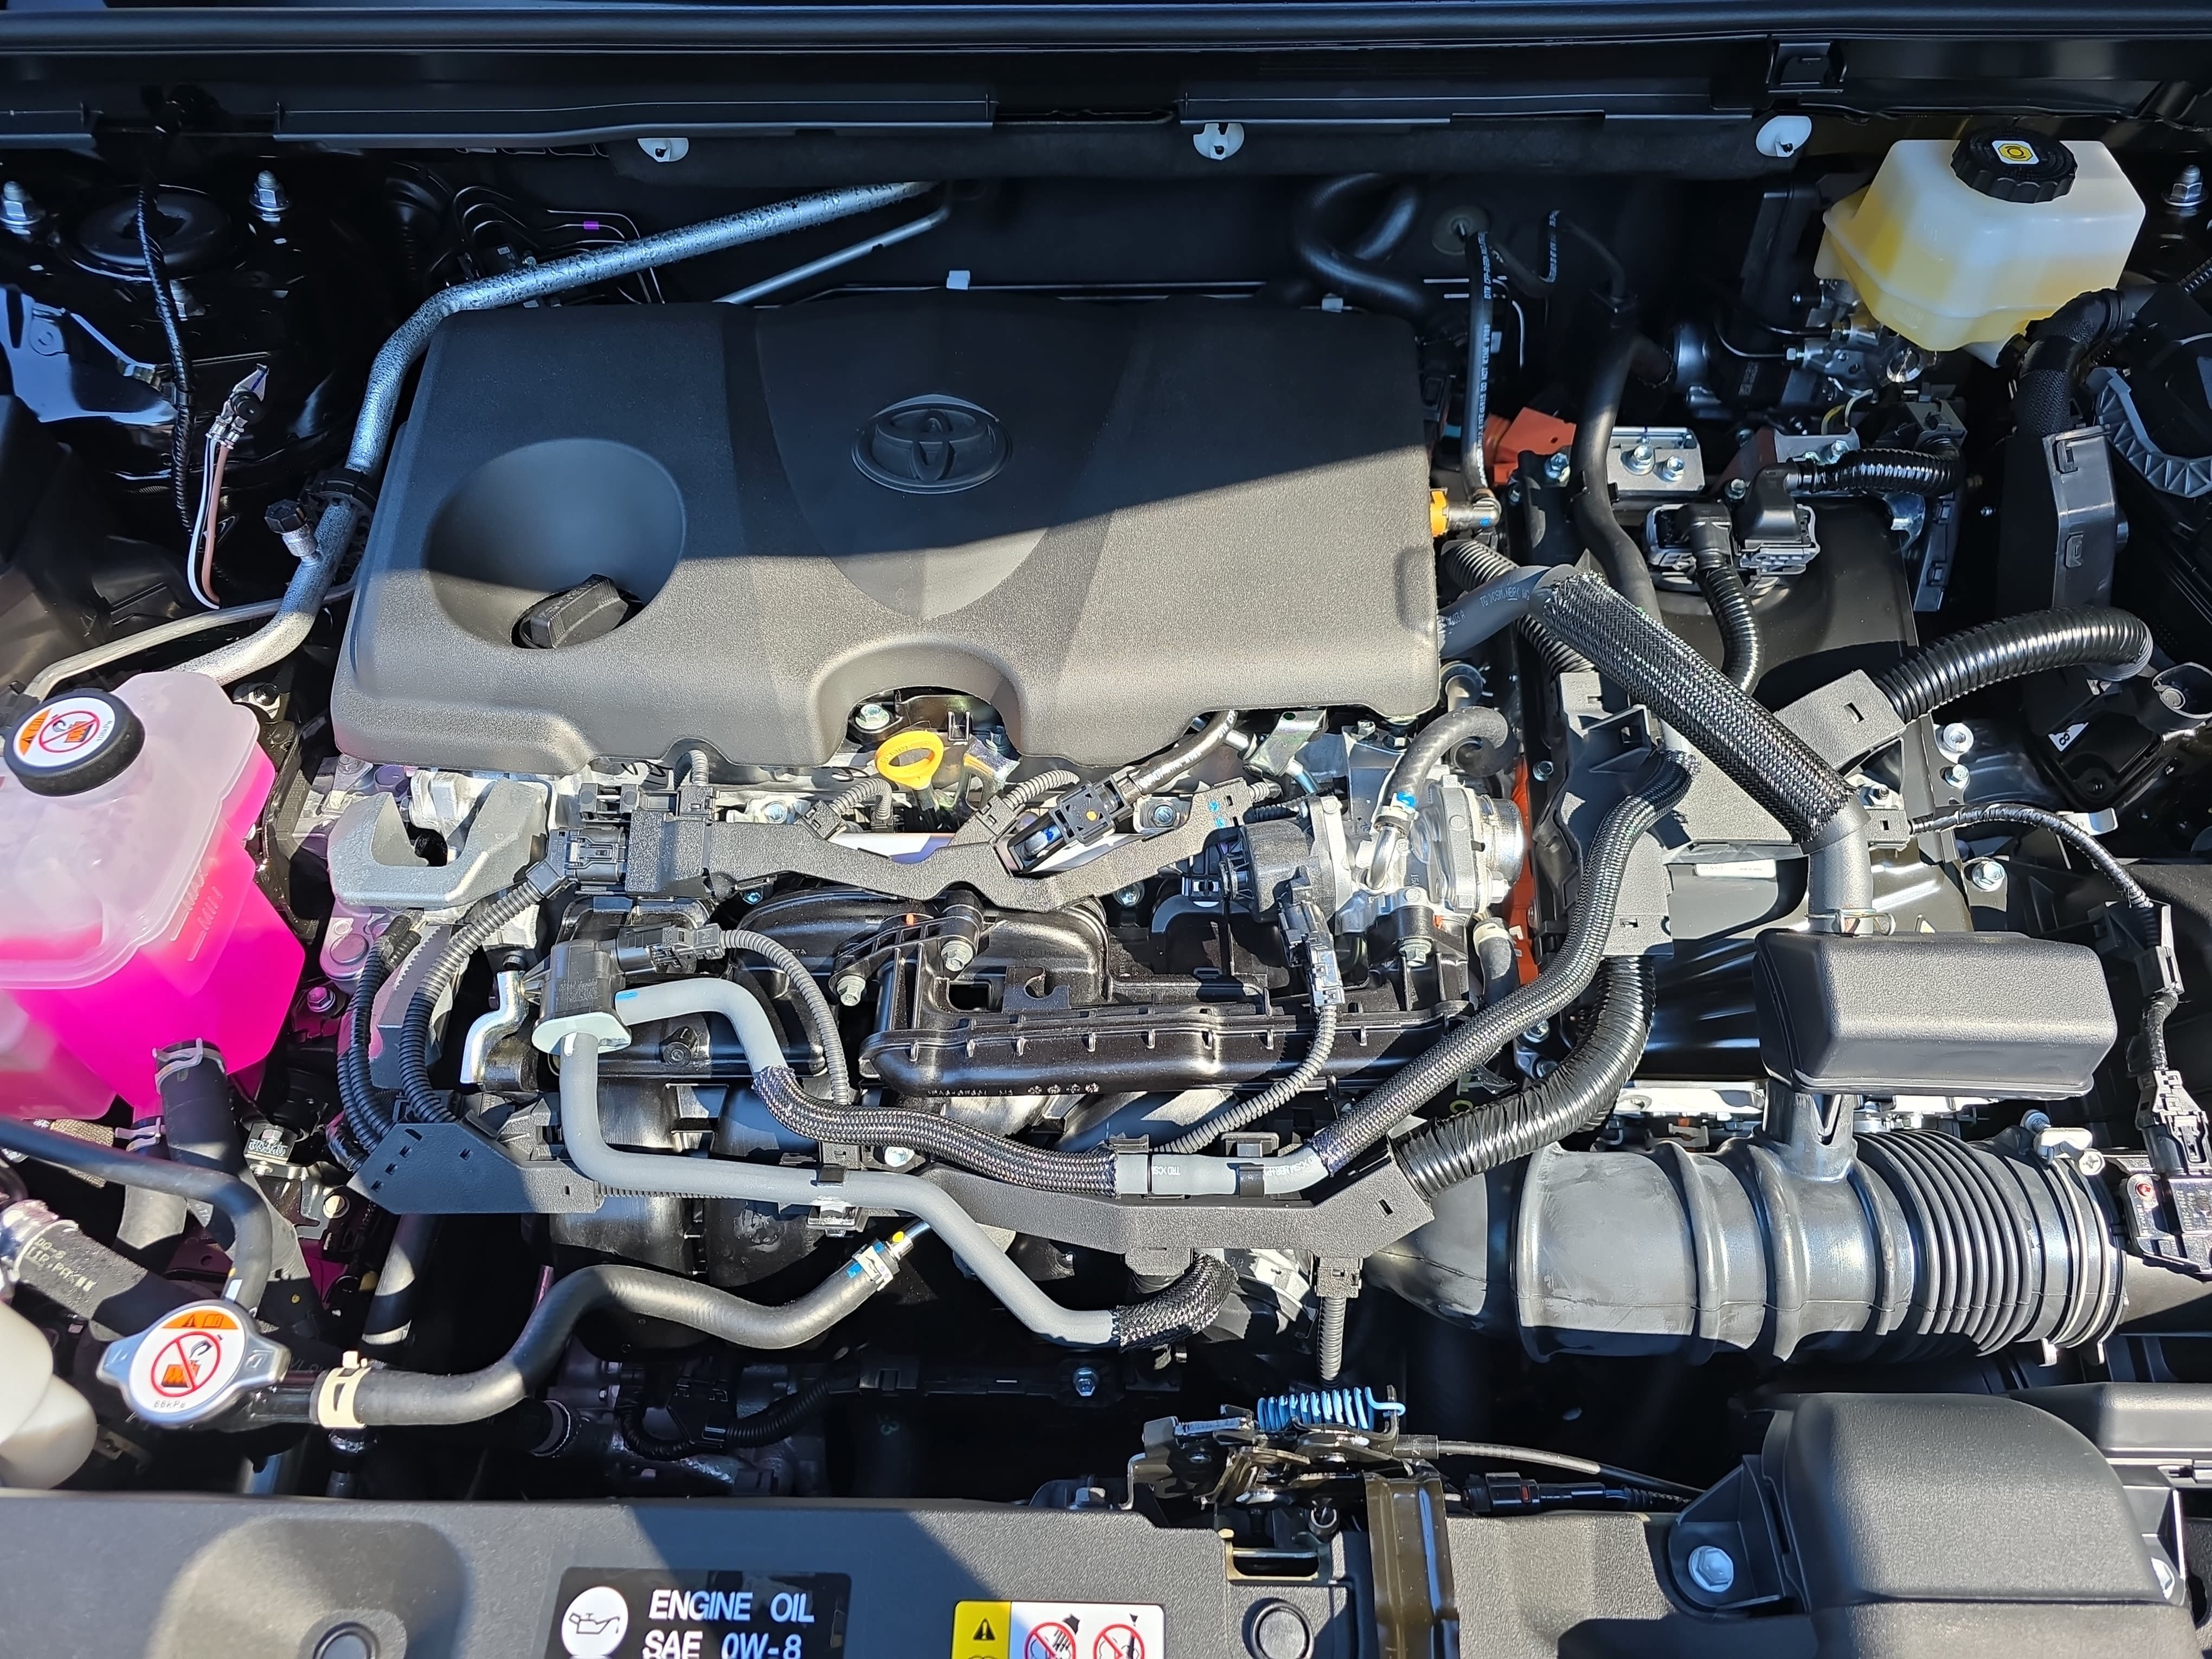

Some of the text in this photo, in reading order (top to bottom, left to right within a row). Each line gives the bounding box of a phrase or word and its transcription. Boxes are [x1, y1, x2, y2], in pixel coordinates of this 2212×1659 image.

[648, 1589, 815, 1623] ENGINE OIL
[642, 1629, 802, 1659] SAE 0W-8
